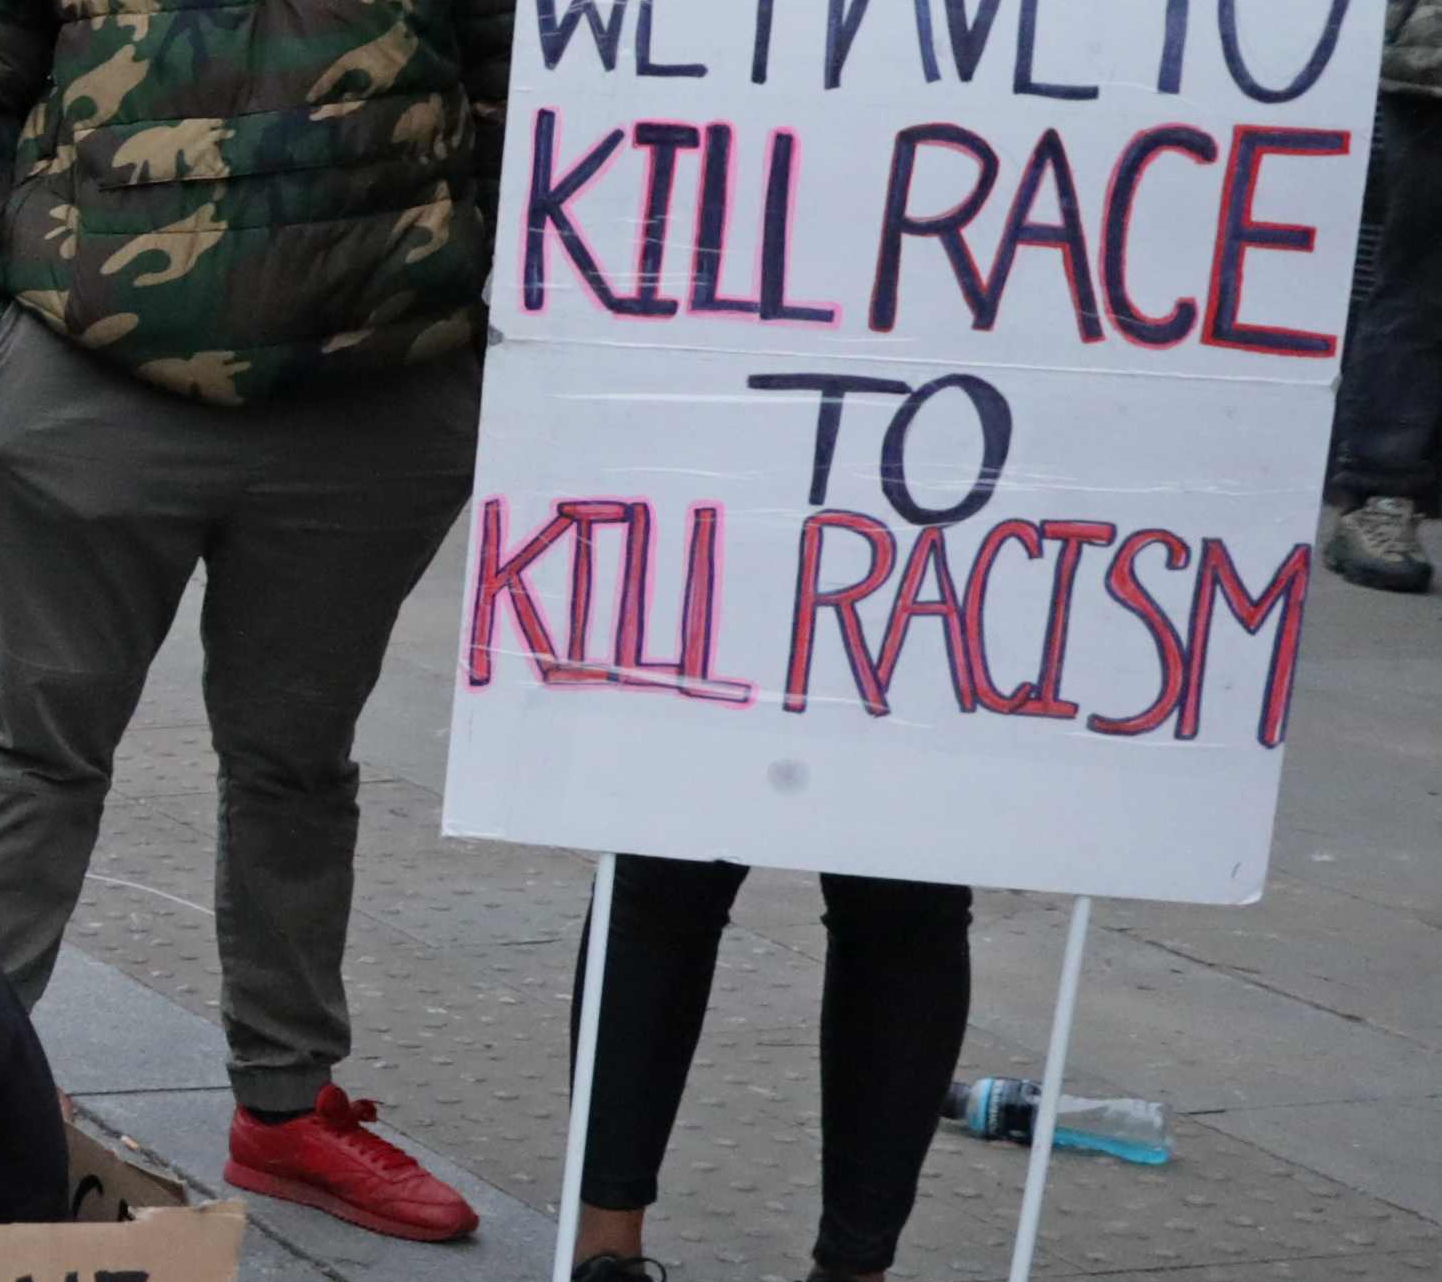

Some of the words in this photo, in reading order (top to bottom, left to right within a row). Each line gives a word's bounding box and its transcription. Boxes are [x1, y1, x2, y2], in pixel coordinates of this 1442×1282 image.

[519, 106, 845, 329] KILL
[867, 122, 1352, 360] RACE
[746, 373, 1014, 526] TO
[465, 494, 761, 710] KILL
[783, 508, 1314, 750] RACISM
